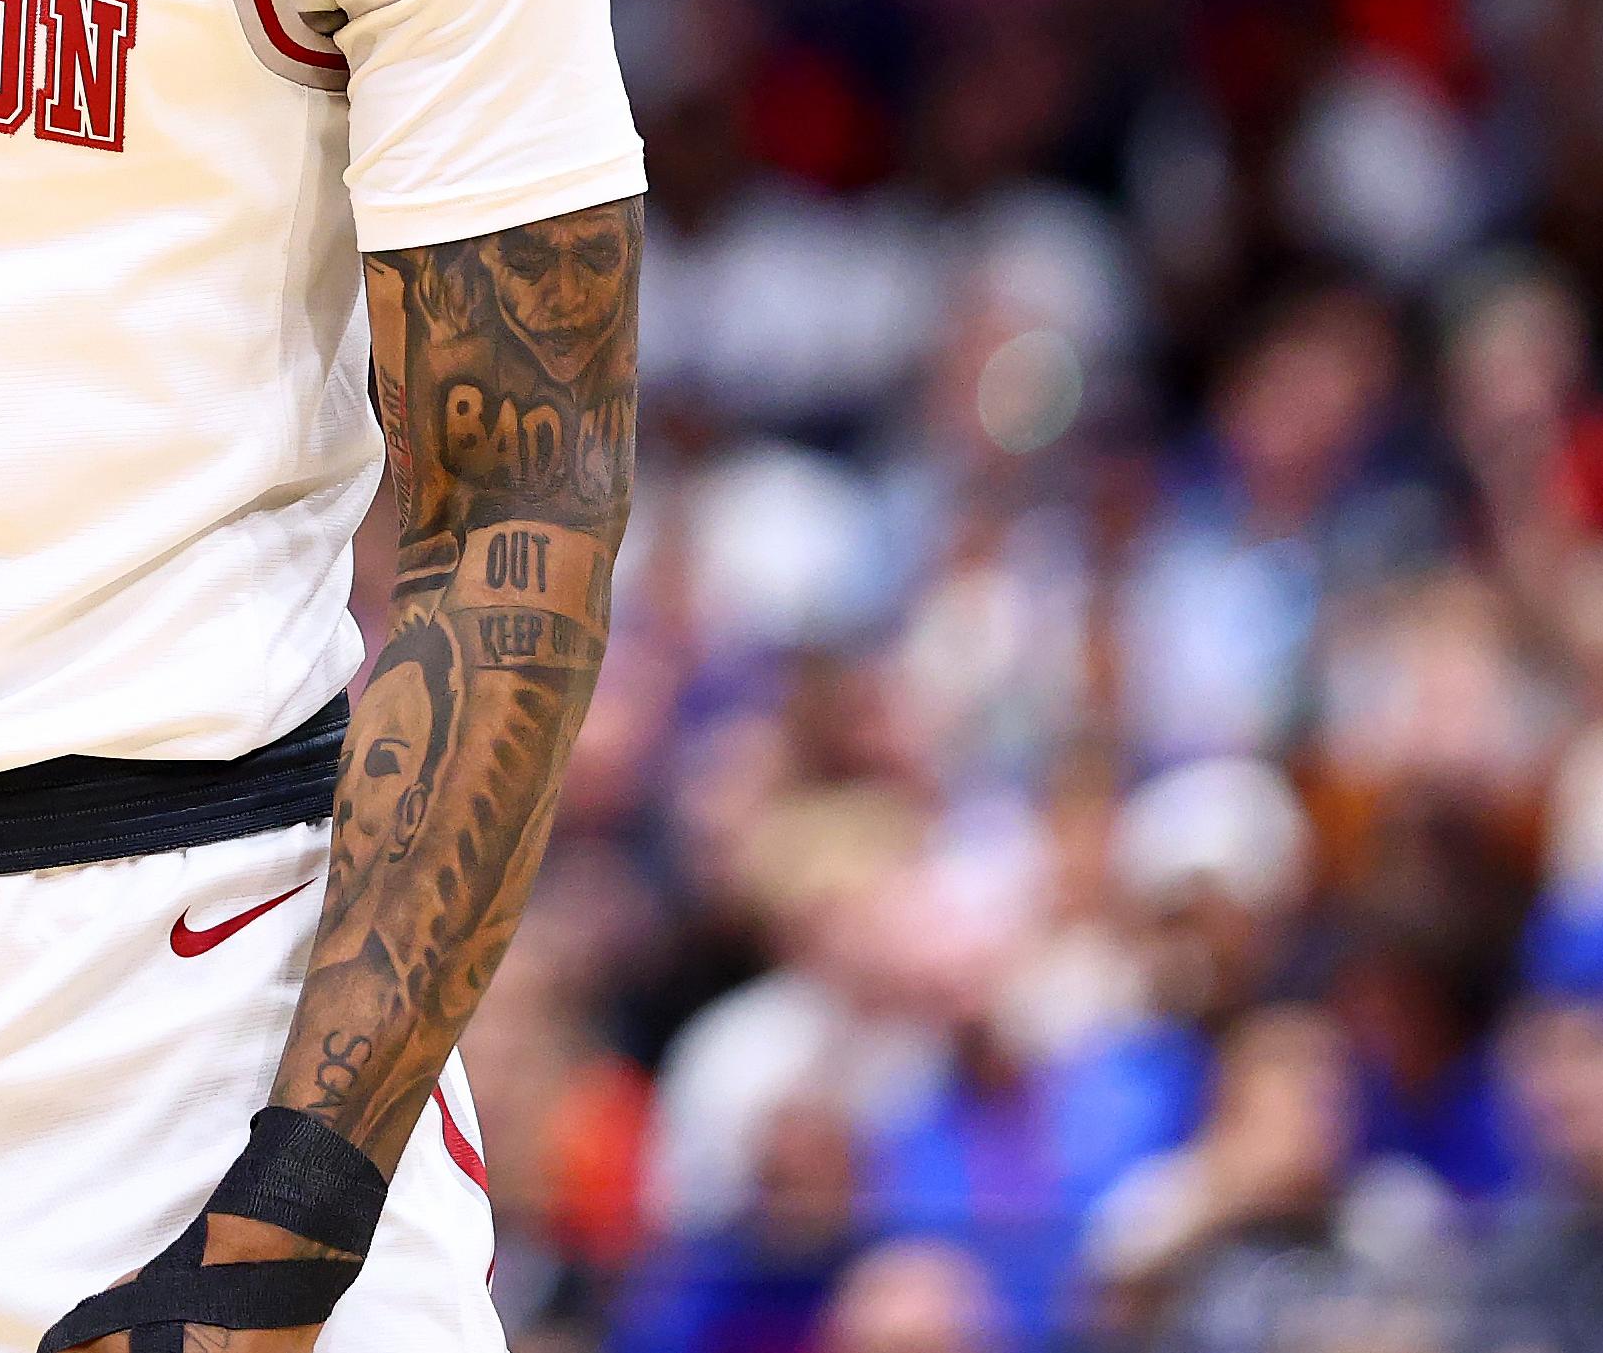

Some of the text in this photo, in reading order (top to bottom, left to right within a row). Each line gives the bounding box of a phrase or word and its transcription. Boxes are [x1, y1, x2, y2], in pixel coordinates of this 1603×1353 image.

[445, 384, 564, 490] BAD
[486, 531, 551, 593] OUT
[479, 615, 544, 664] KEEP
